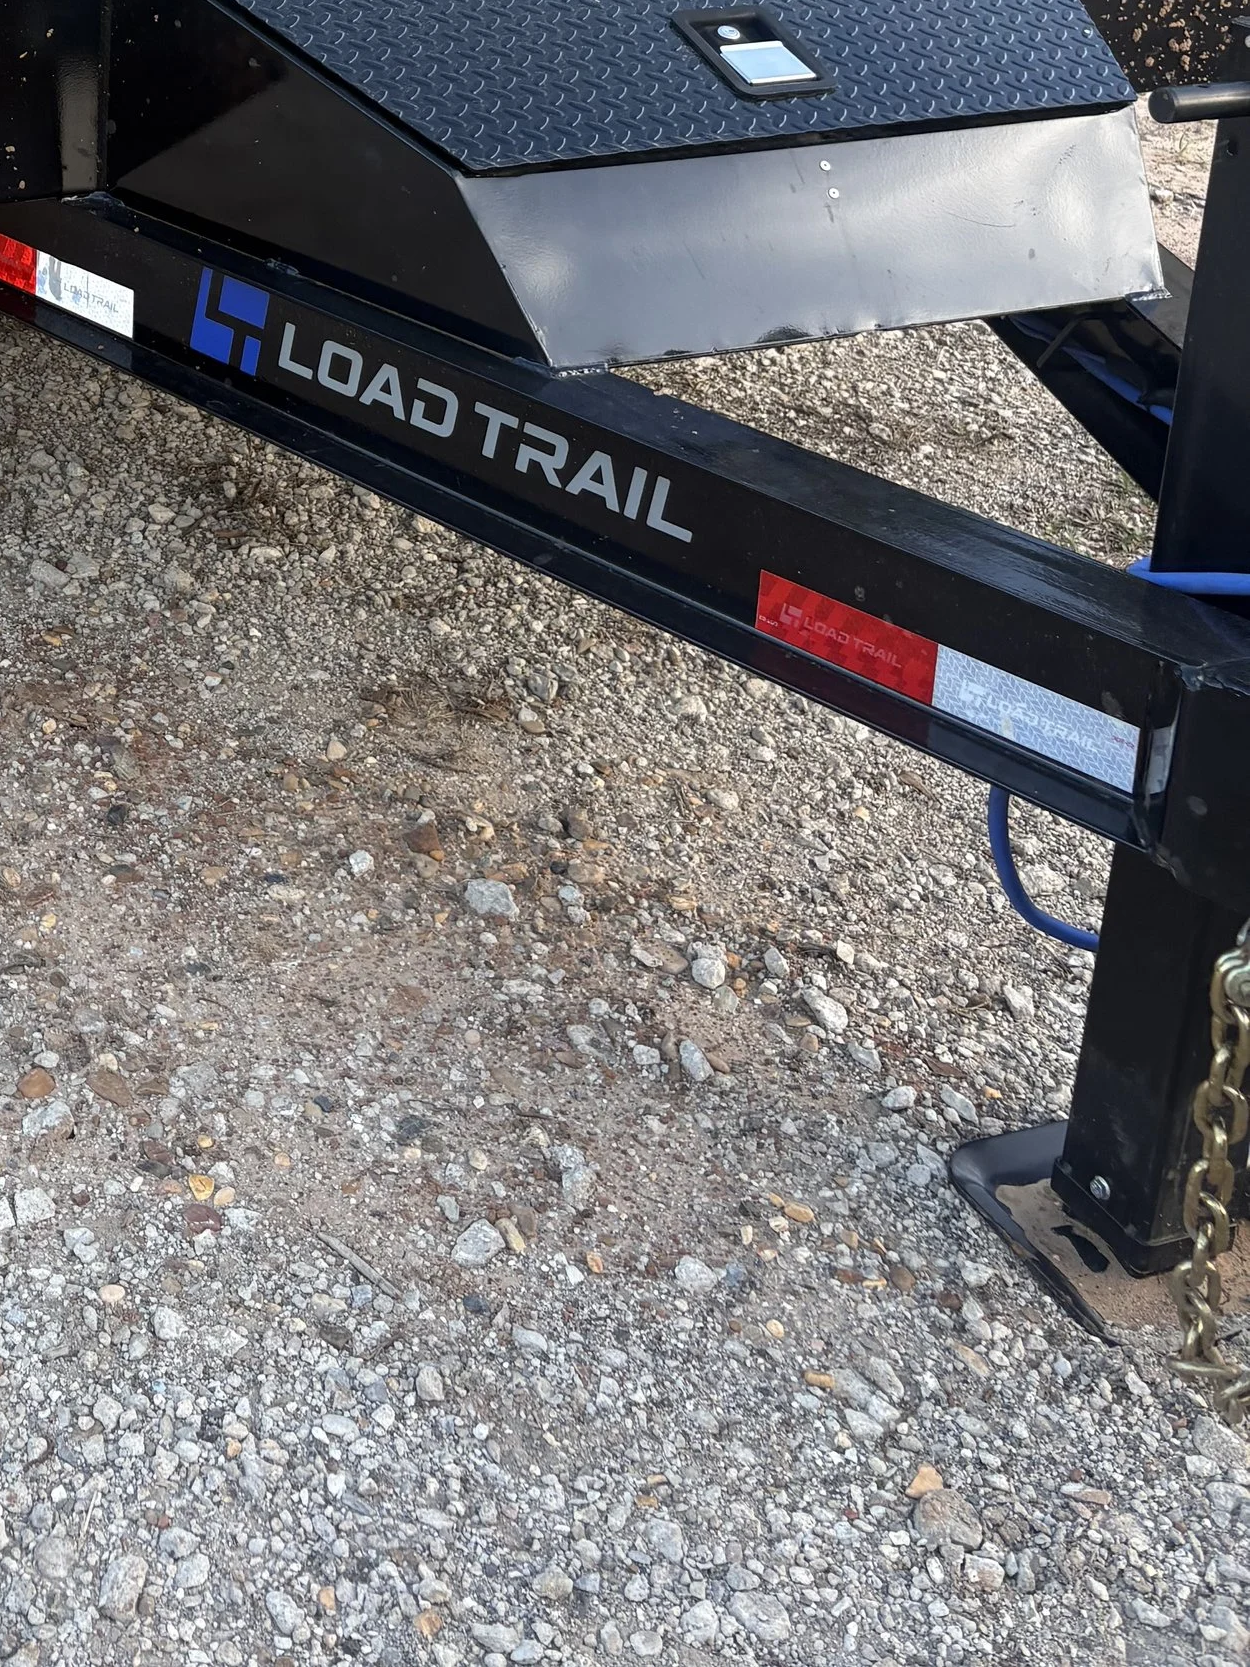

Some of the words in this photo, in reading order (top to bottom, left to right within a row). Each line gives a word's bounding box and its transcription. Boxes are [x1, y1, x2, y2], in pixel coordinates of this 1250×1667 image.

[92, 294, 119, 313] TRAIL
[278, 322, 459, 438] LOAD
[474, 401, 693, 542] TRAIL
[803, 616, 849, 644] LOAD
[853, 637, 902, 668] TRAIL
